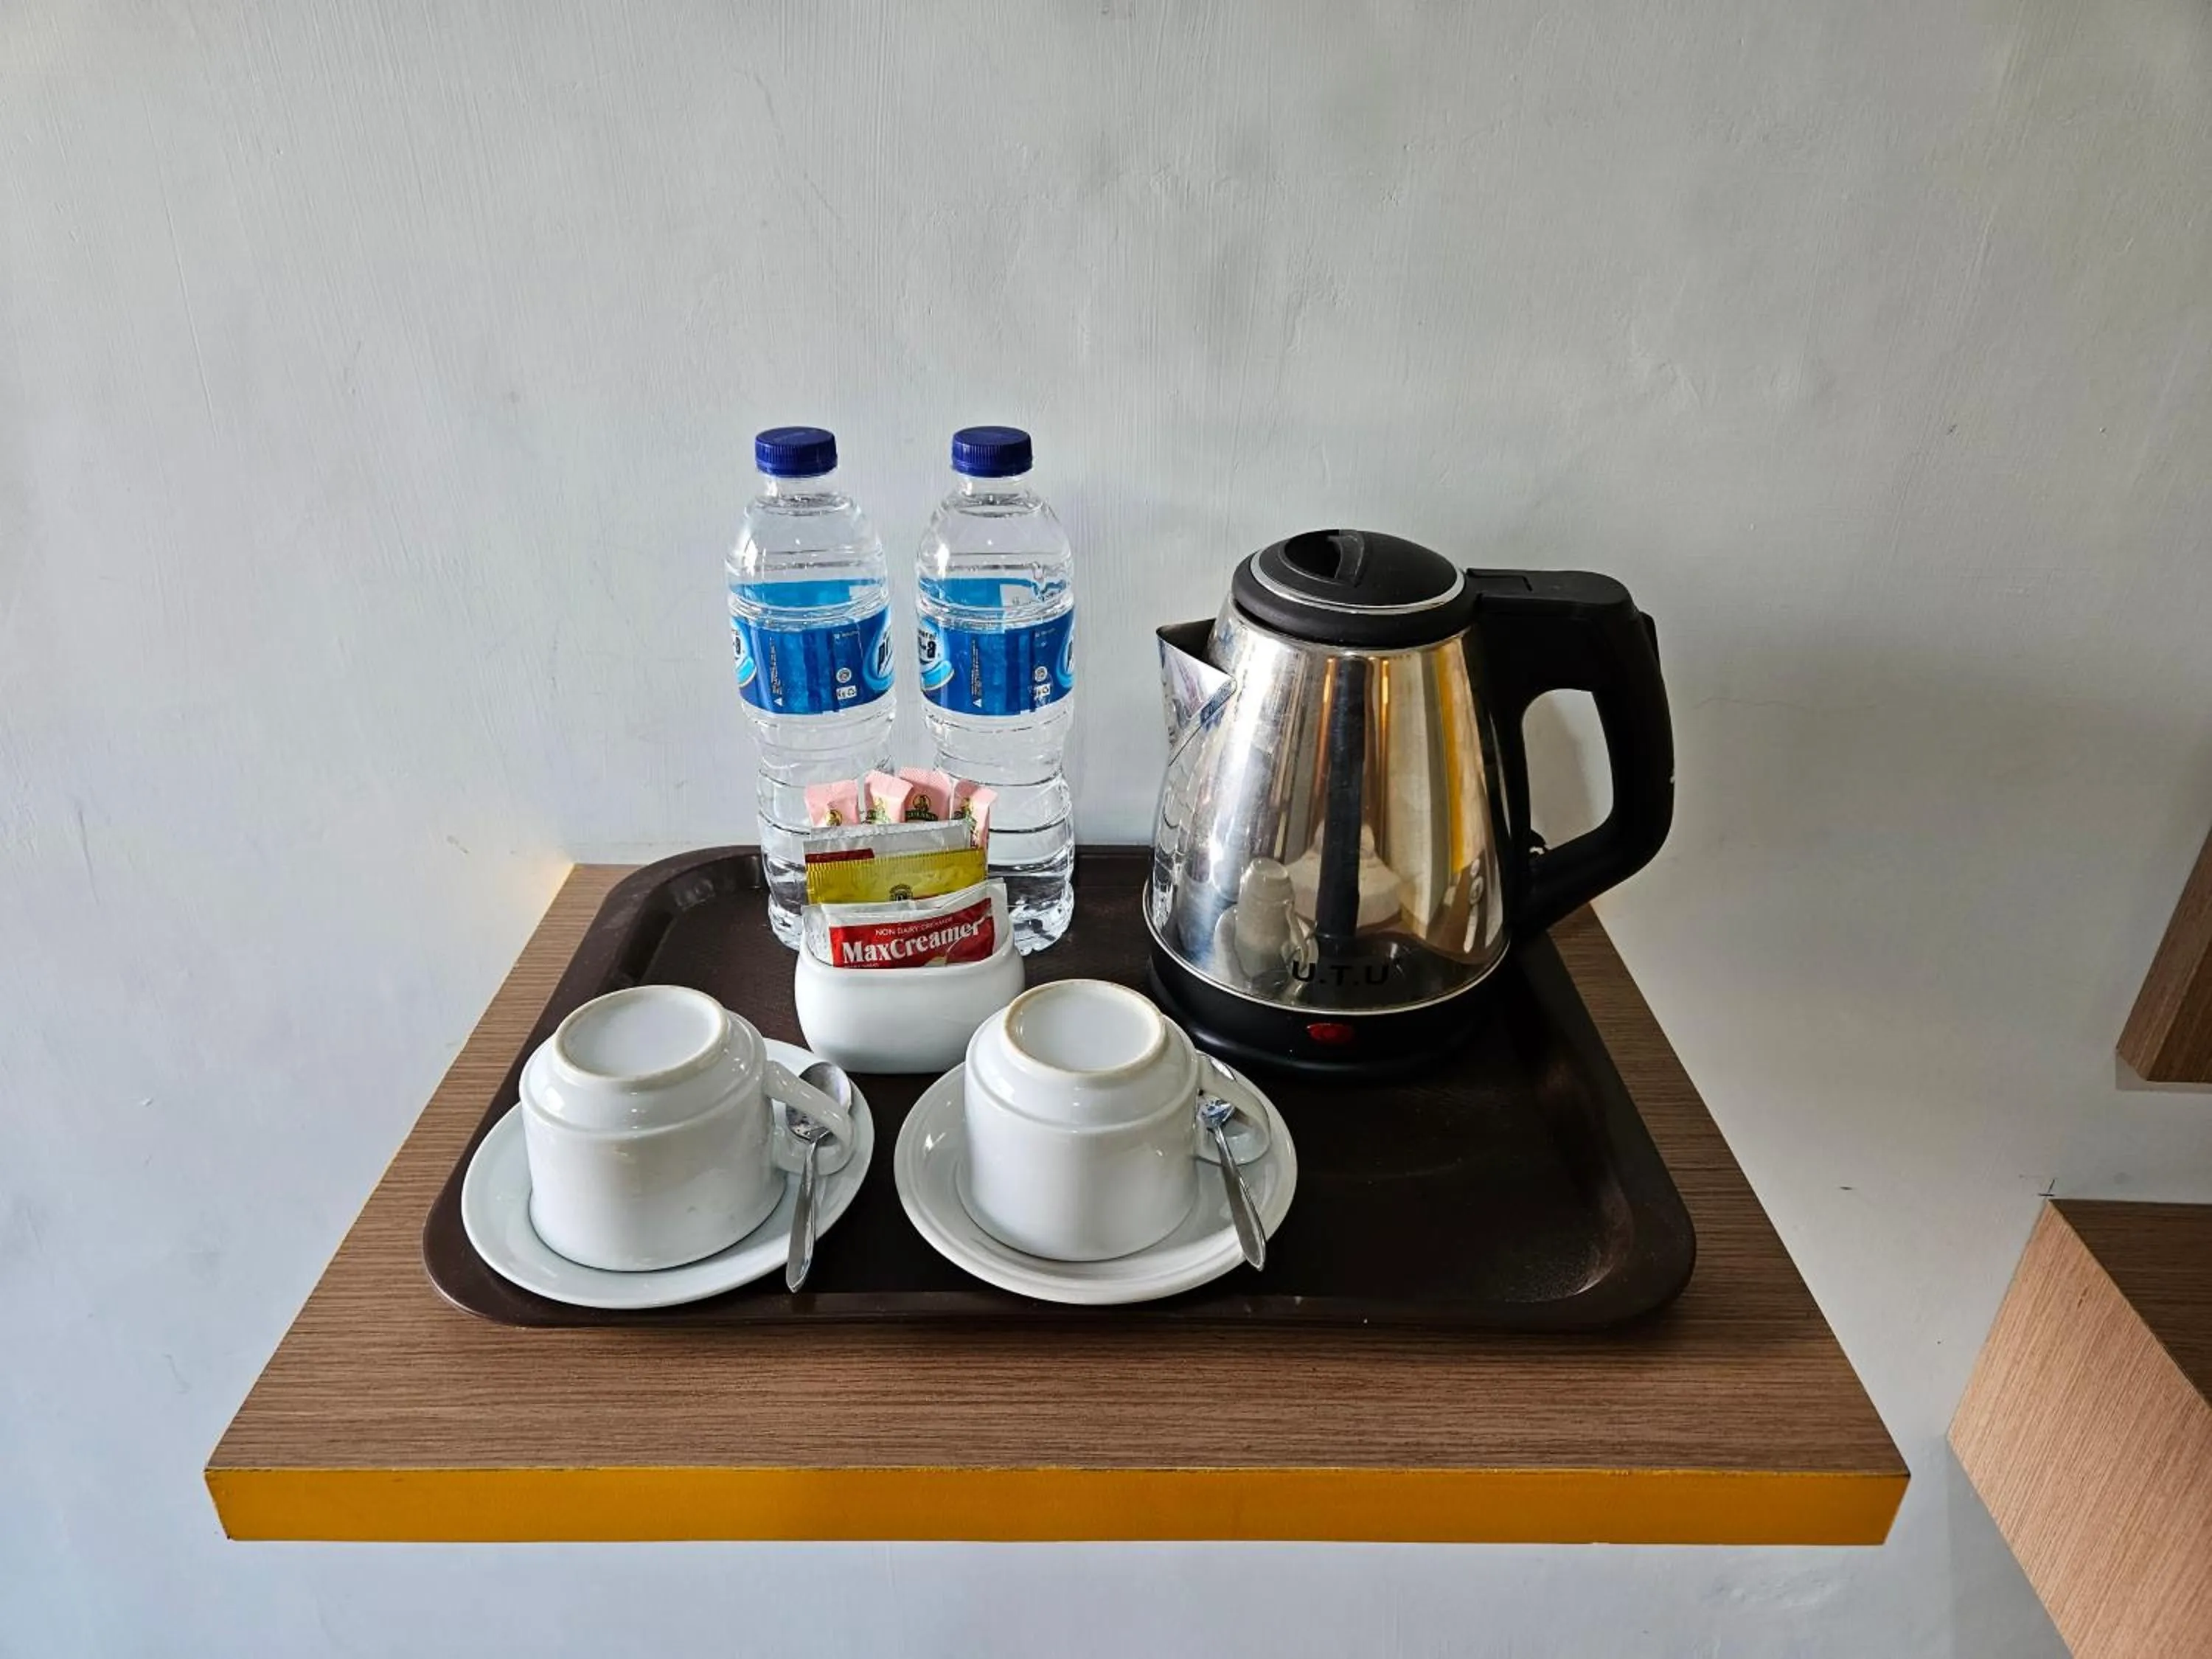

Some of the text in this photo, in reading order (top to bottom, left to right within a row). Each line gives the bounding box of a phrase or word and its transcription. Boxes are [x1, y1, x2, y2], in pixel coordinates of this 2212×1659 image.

[842, 918, 984, 964] MaxCreamer
[875, 928, 896, 936] NON
[897, 926, 919, 936] DAIRY
[1293, 960, 1390, 986] U.T.U
